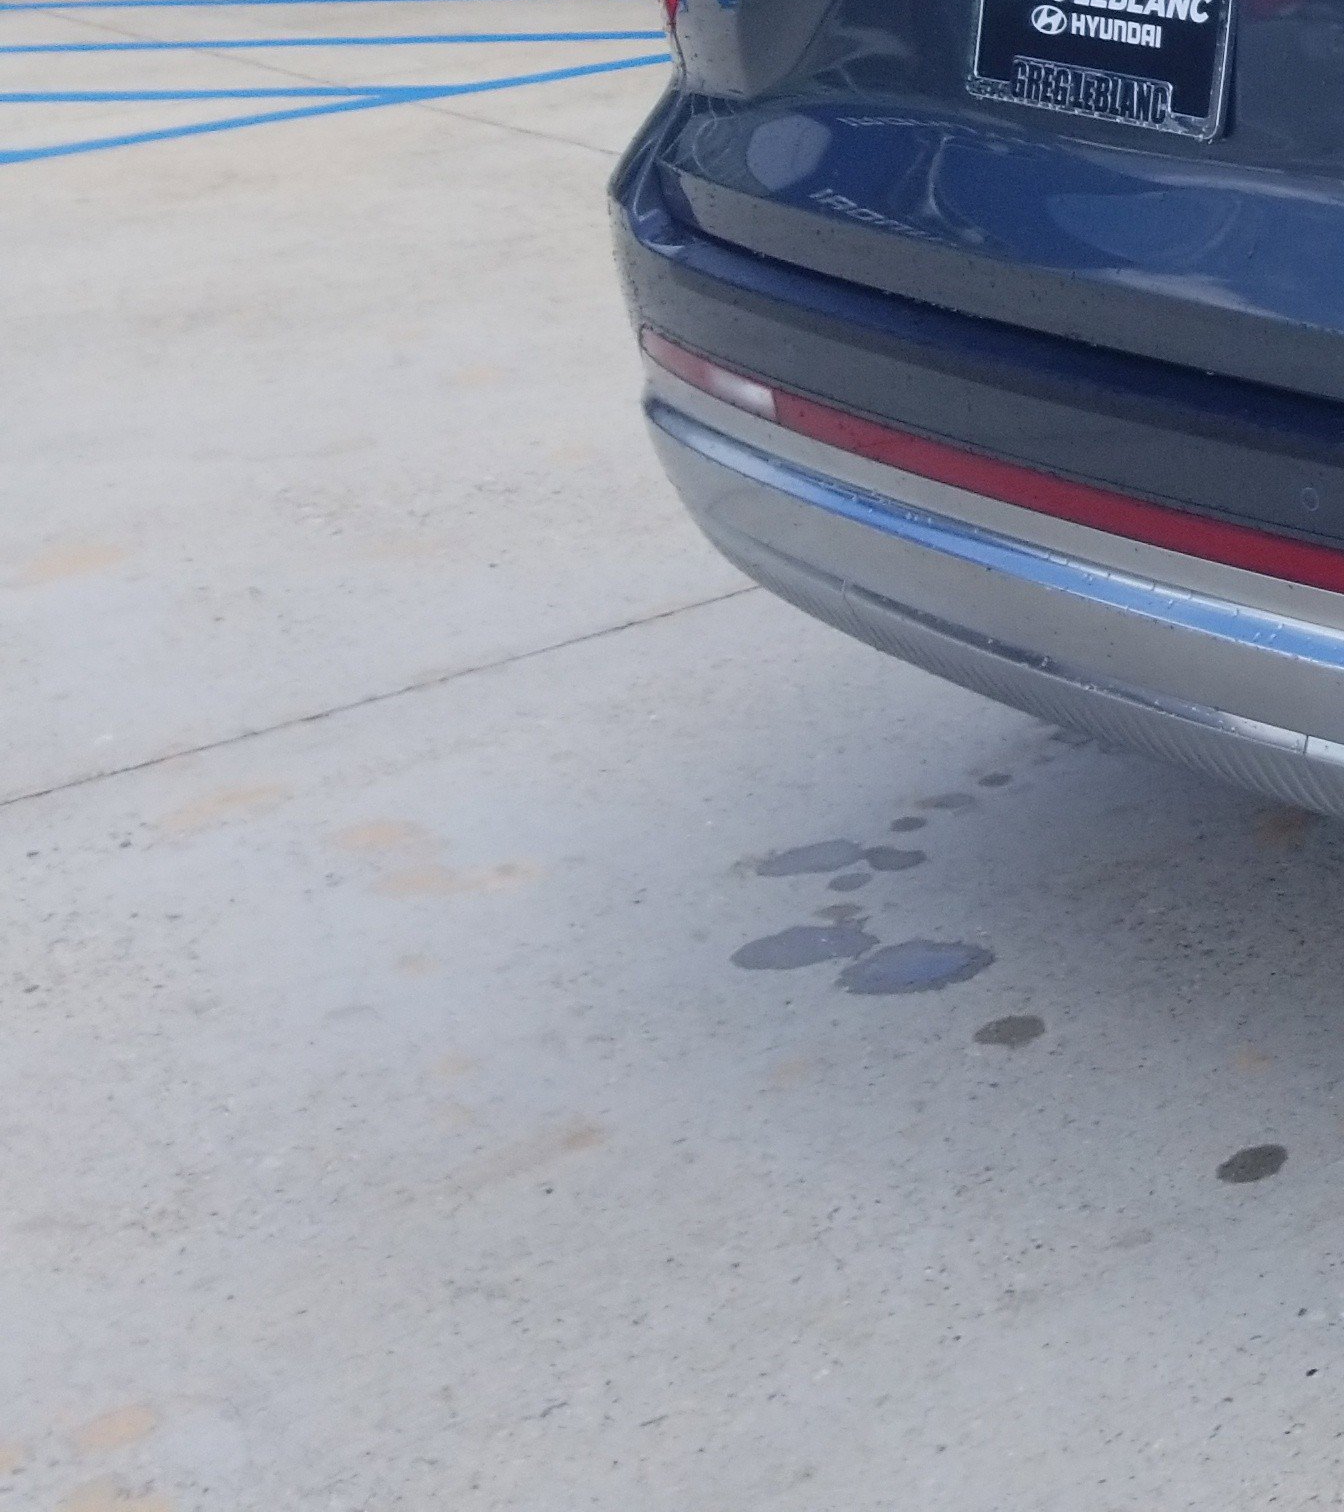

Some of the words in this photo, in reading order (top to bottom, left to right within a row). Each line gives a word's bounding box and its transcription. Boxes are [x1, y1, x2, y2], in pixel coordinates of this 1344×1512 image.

[1071, 13, 1162, 48] HYUNDAI
[1011, 61, 1069, 106] GREG
[1071, 71, 1168, 125] LEBLANC
